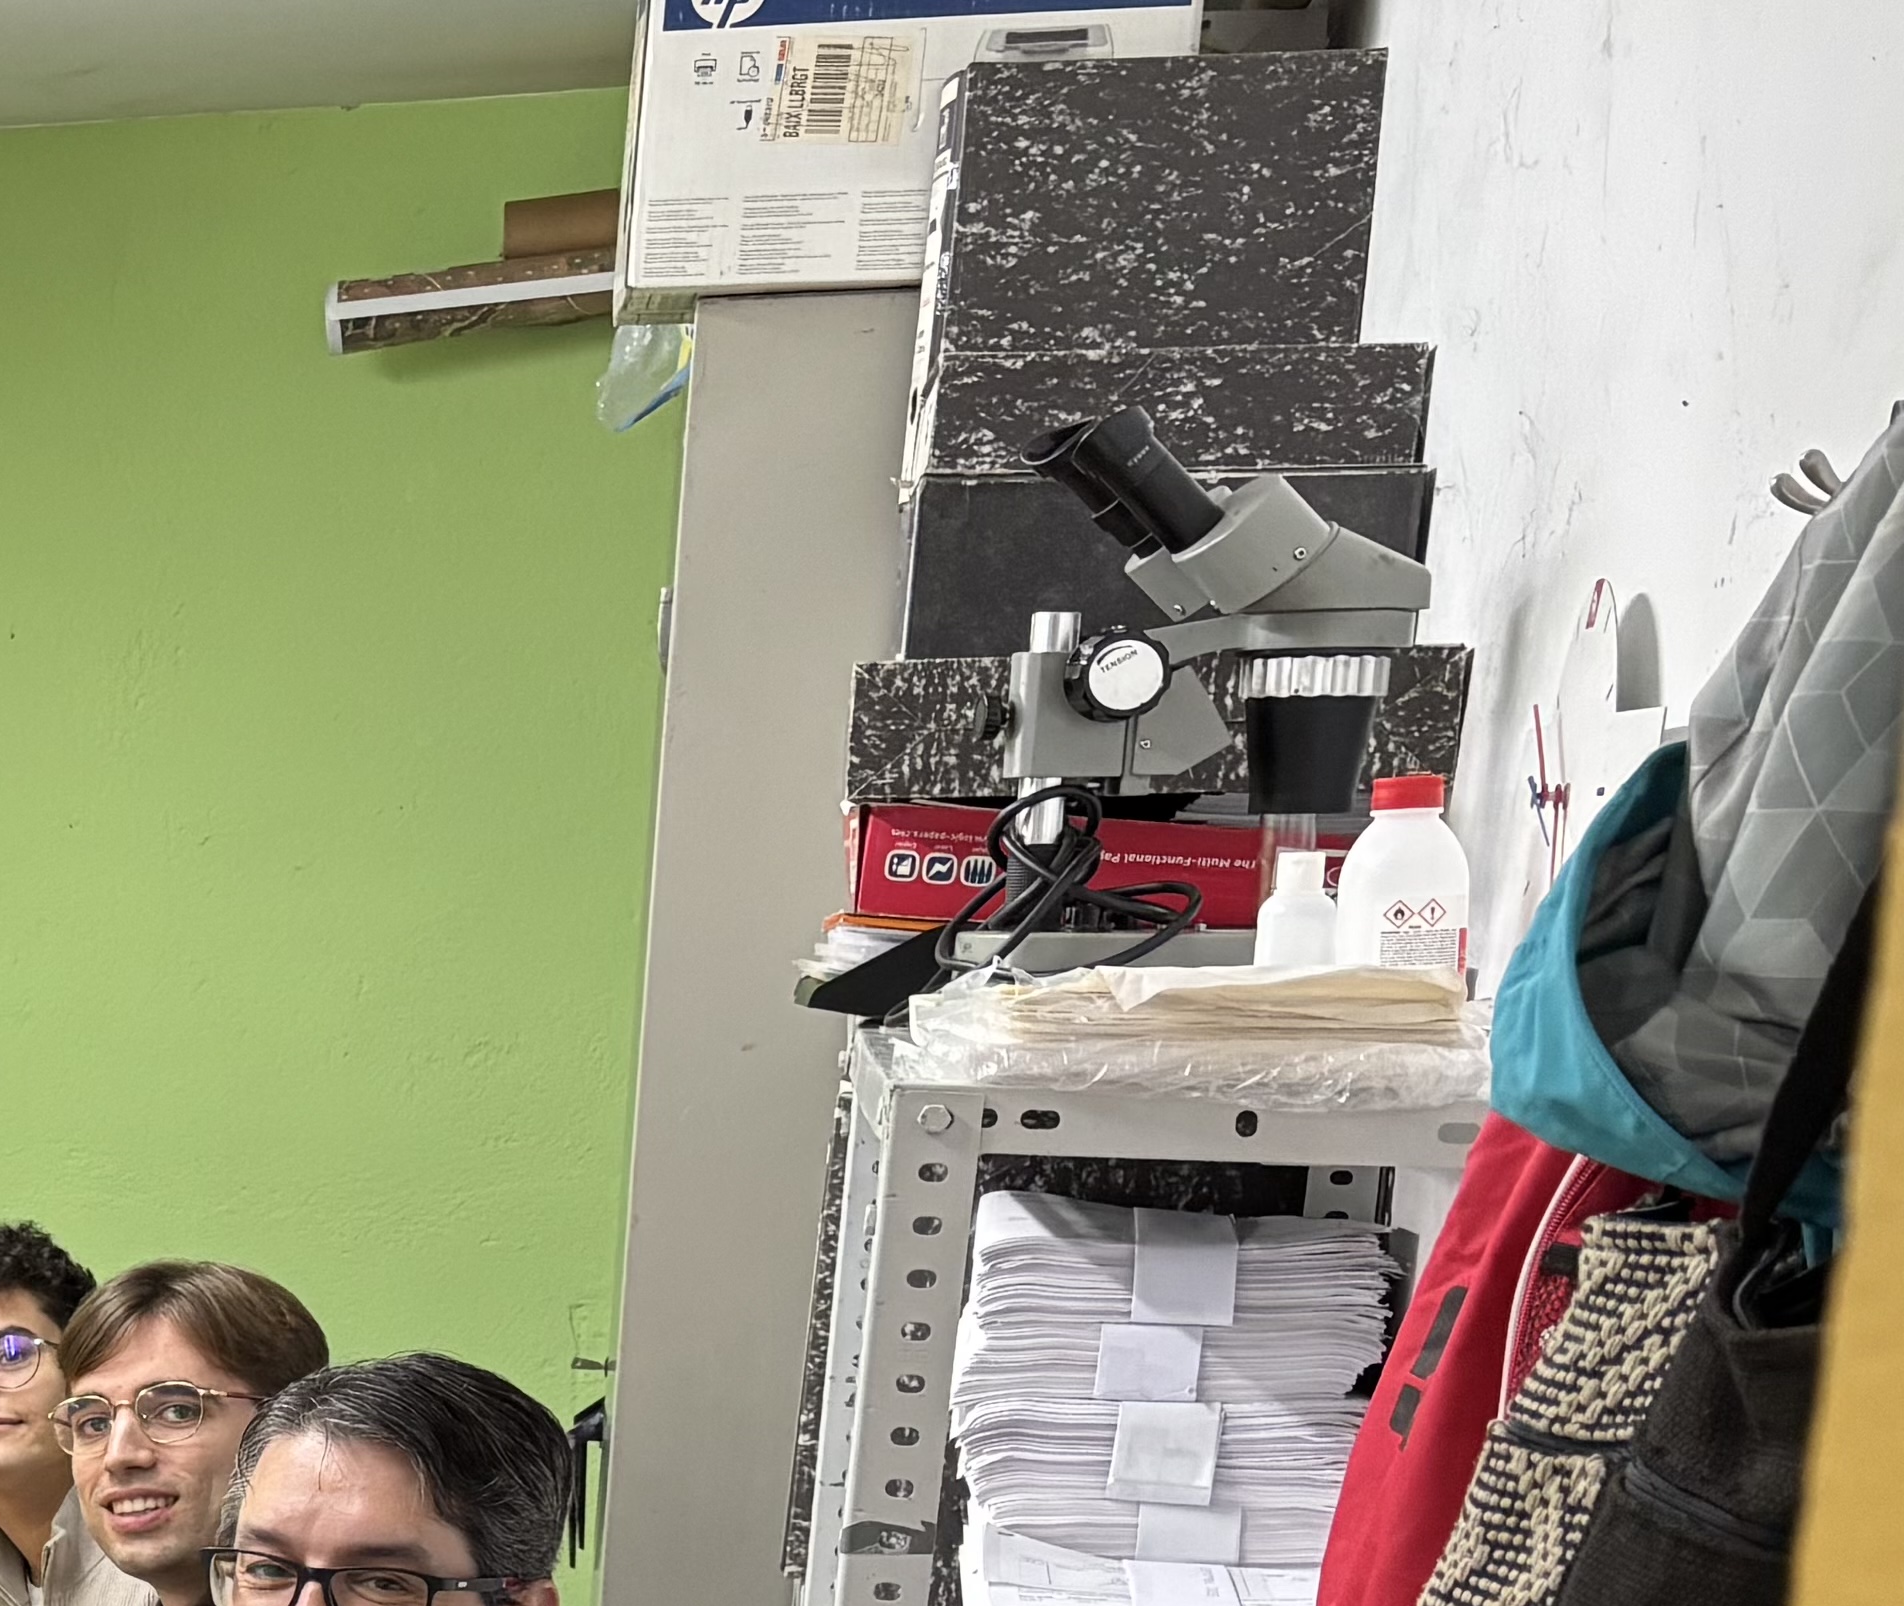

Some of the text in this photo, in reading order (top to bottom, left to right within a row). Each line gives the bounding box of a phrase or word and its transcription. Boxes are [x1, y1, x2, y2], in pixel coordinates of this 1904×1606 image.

[783, 66, 809, 138] BAIX LLBRGT
[1124, 852, 1230, 869] Multi-Functional
